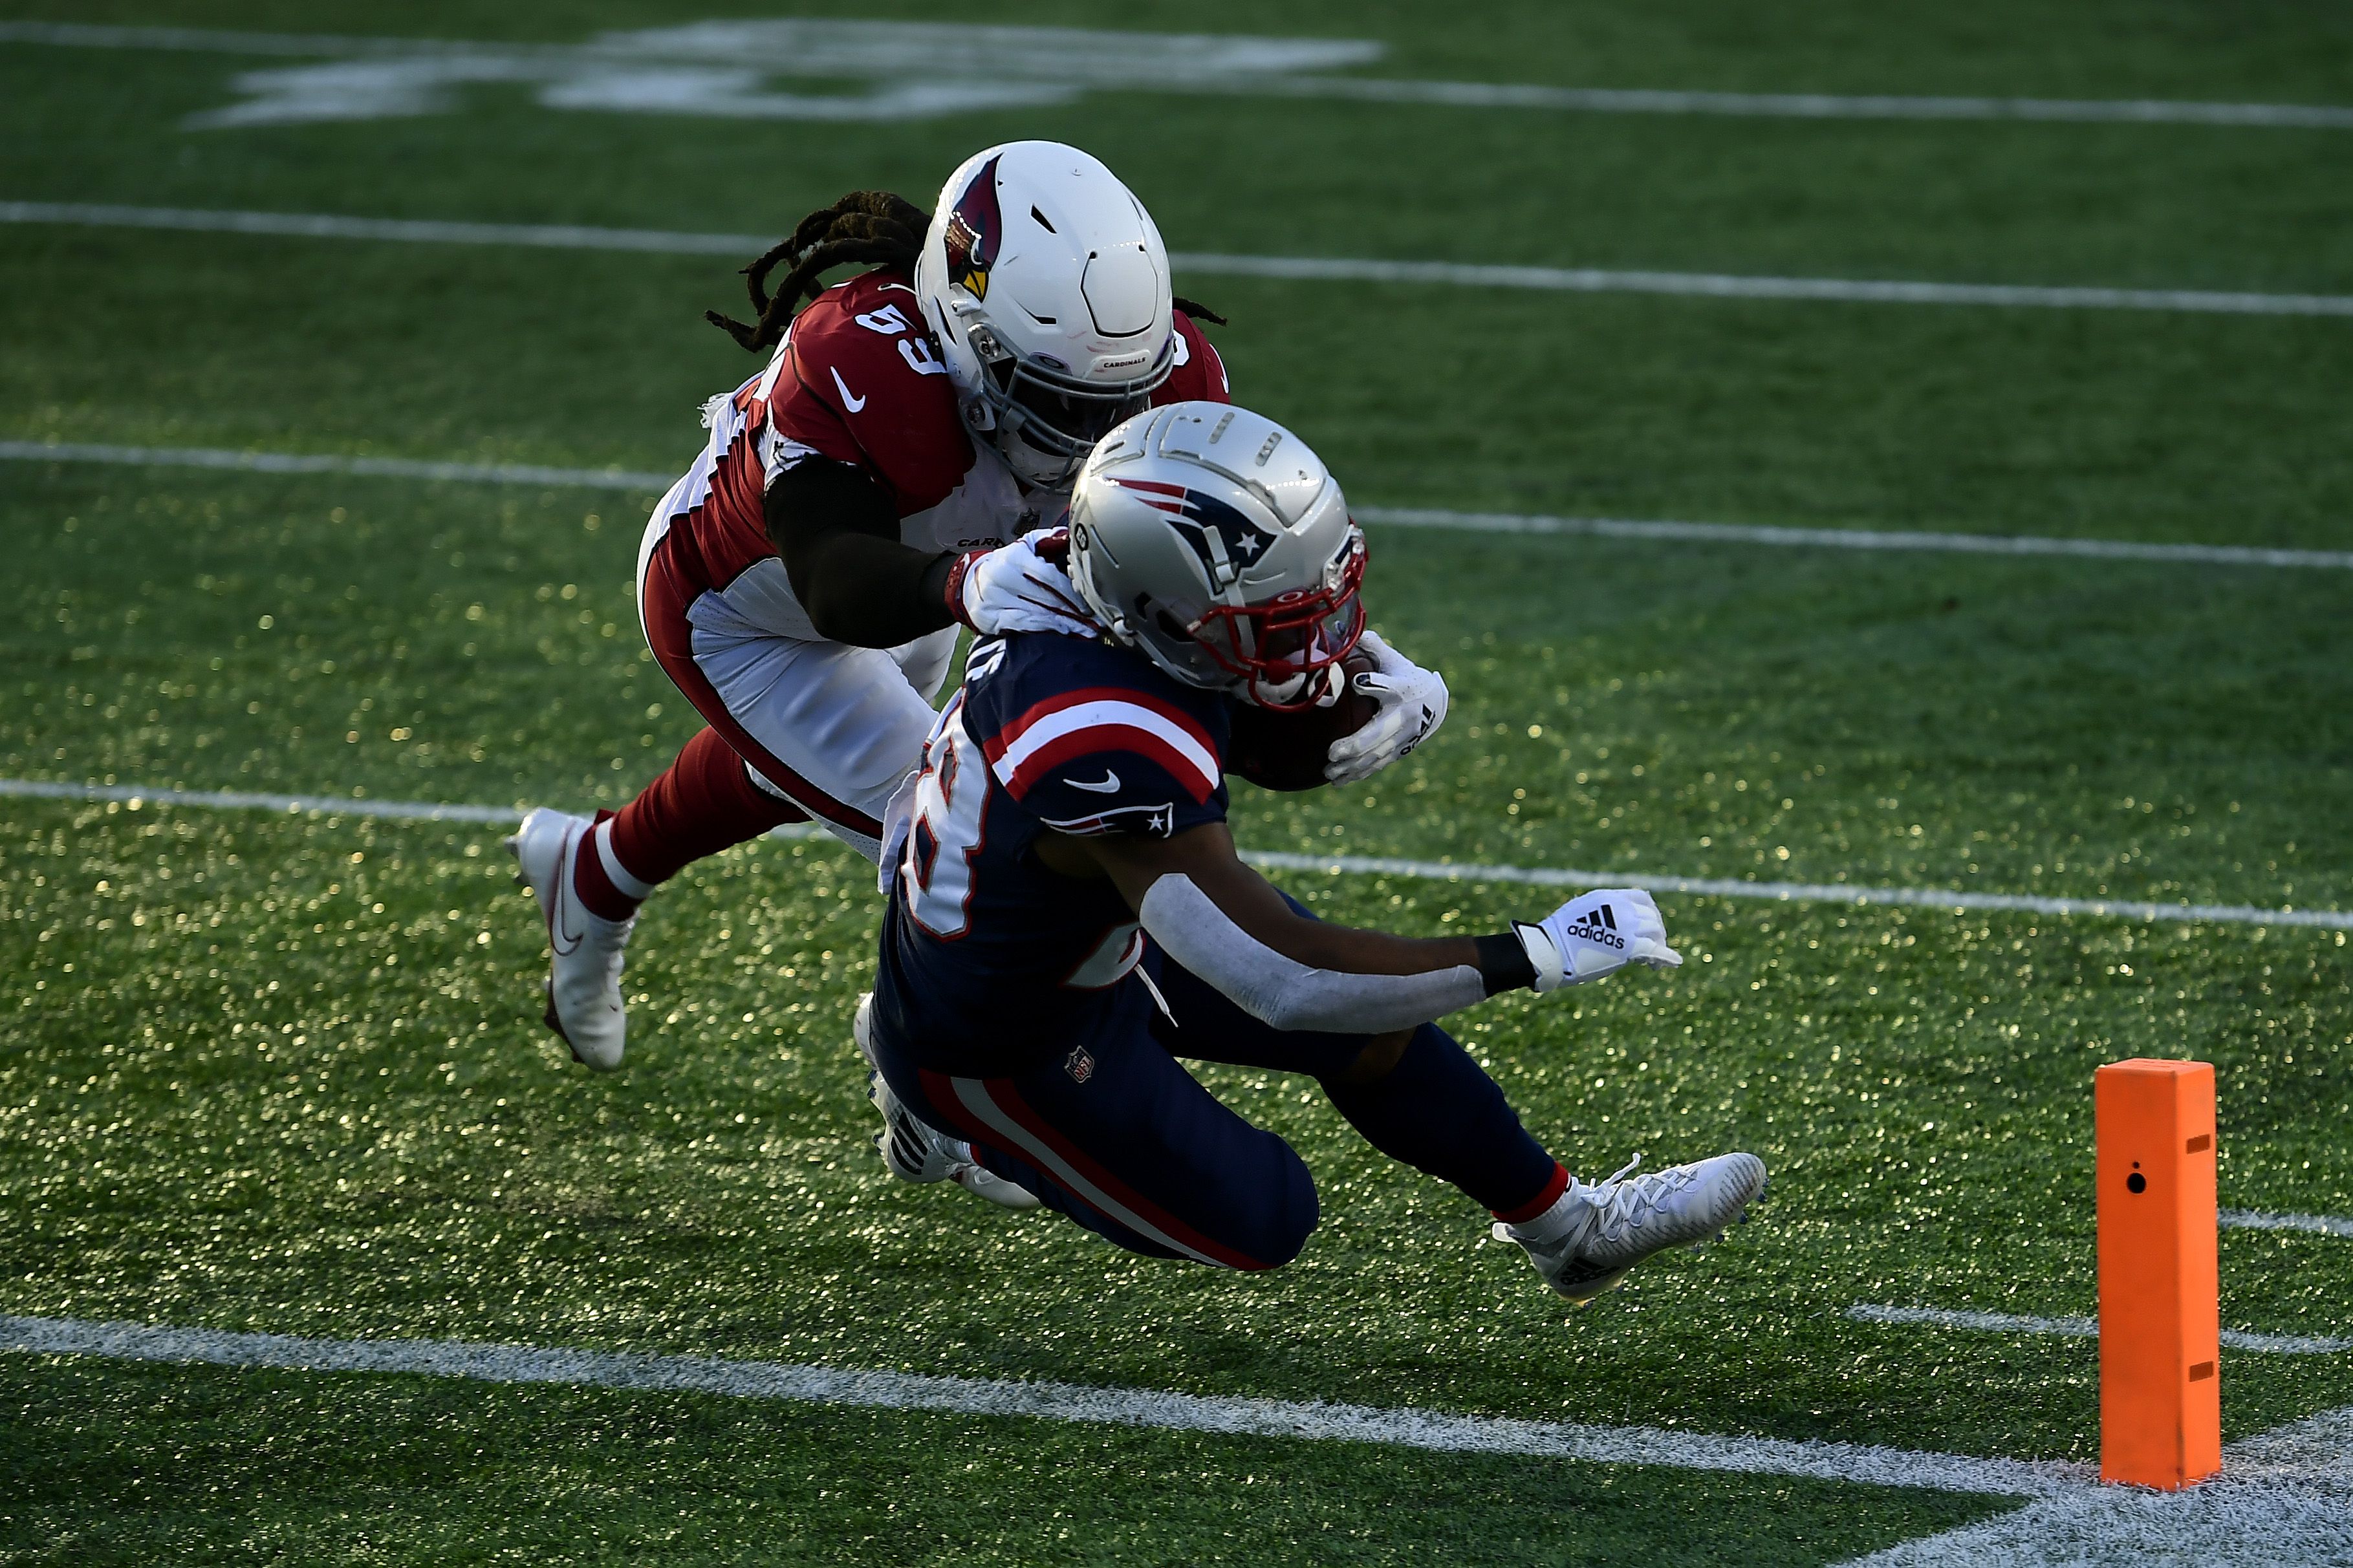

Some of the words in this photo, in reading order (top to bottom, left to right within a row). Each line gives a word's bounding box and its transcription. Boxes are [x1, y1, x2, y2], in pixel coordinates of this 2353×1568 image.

[1103, 357, 1146, 368] CARDINALS
[900, 686, 992, 943] 8
[1567, 925, 1625, 950] adidas
